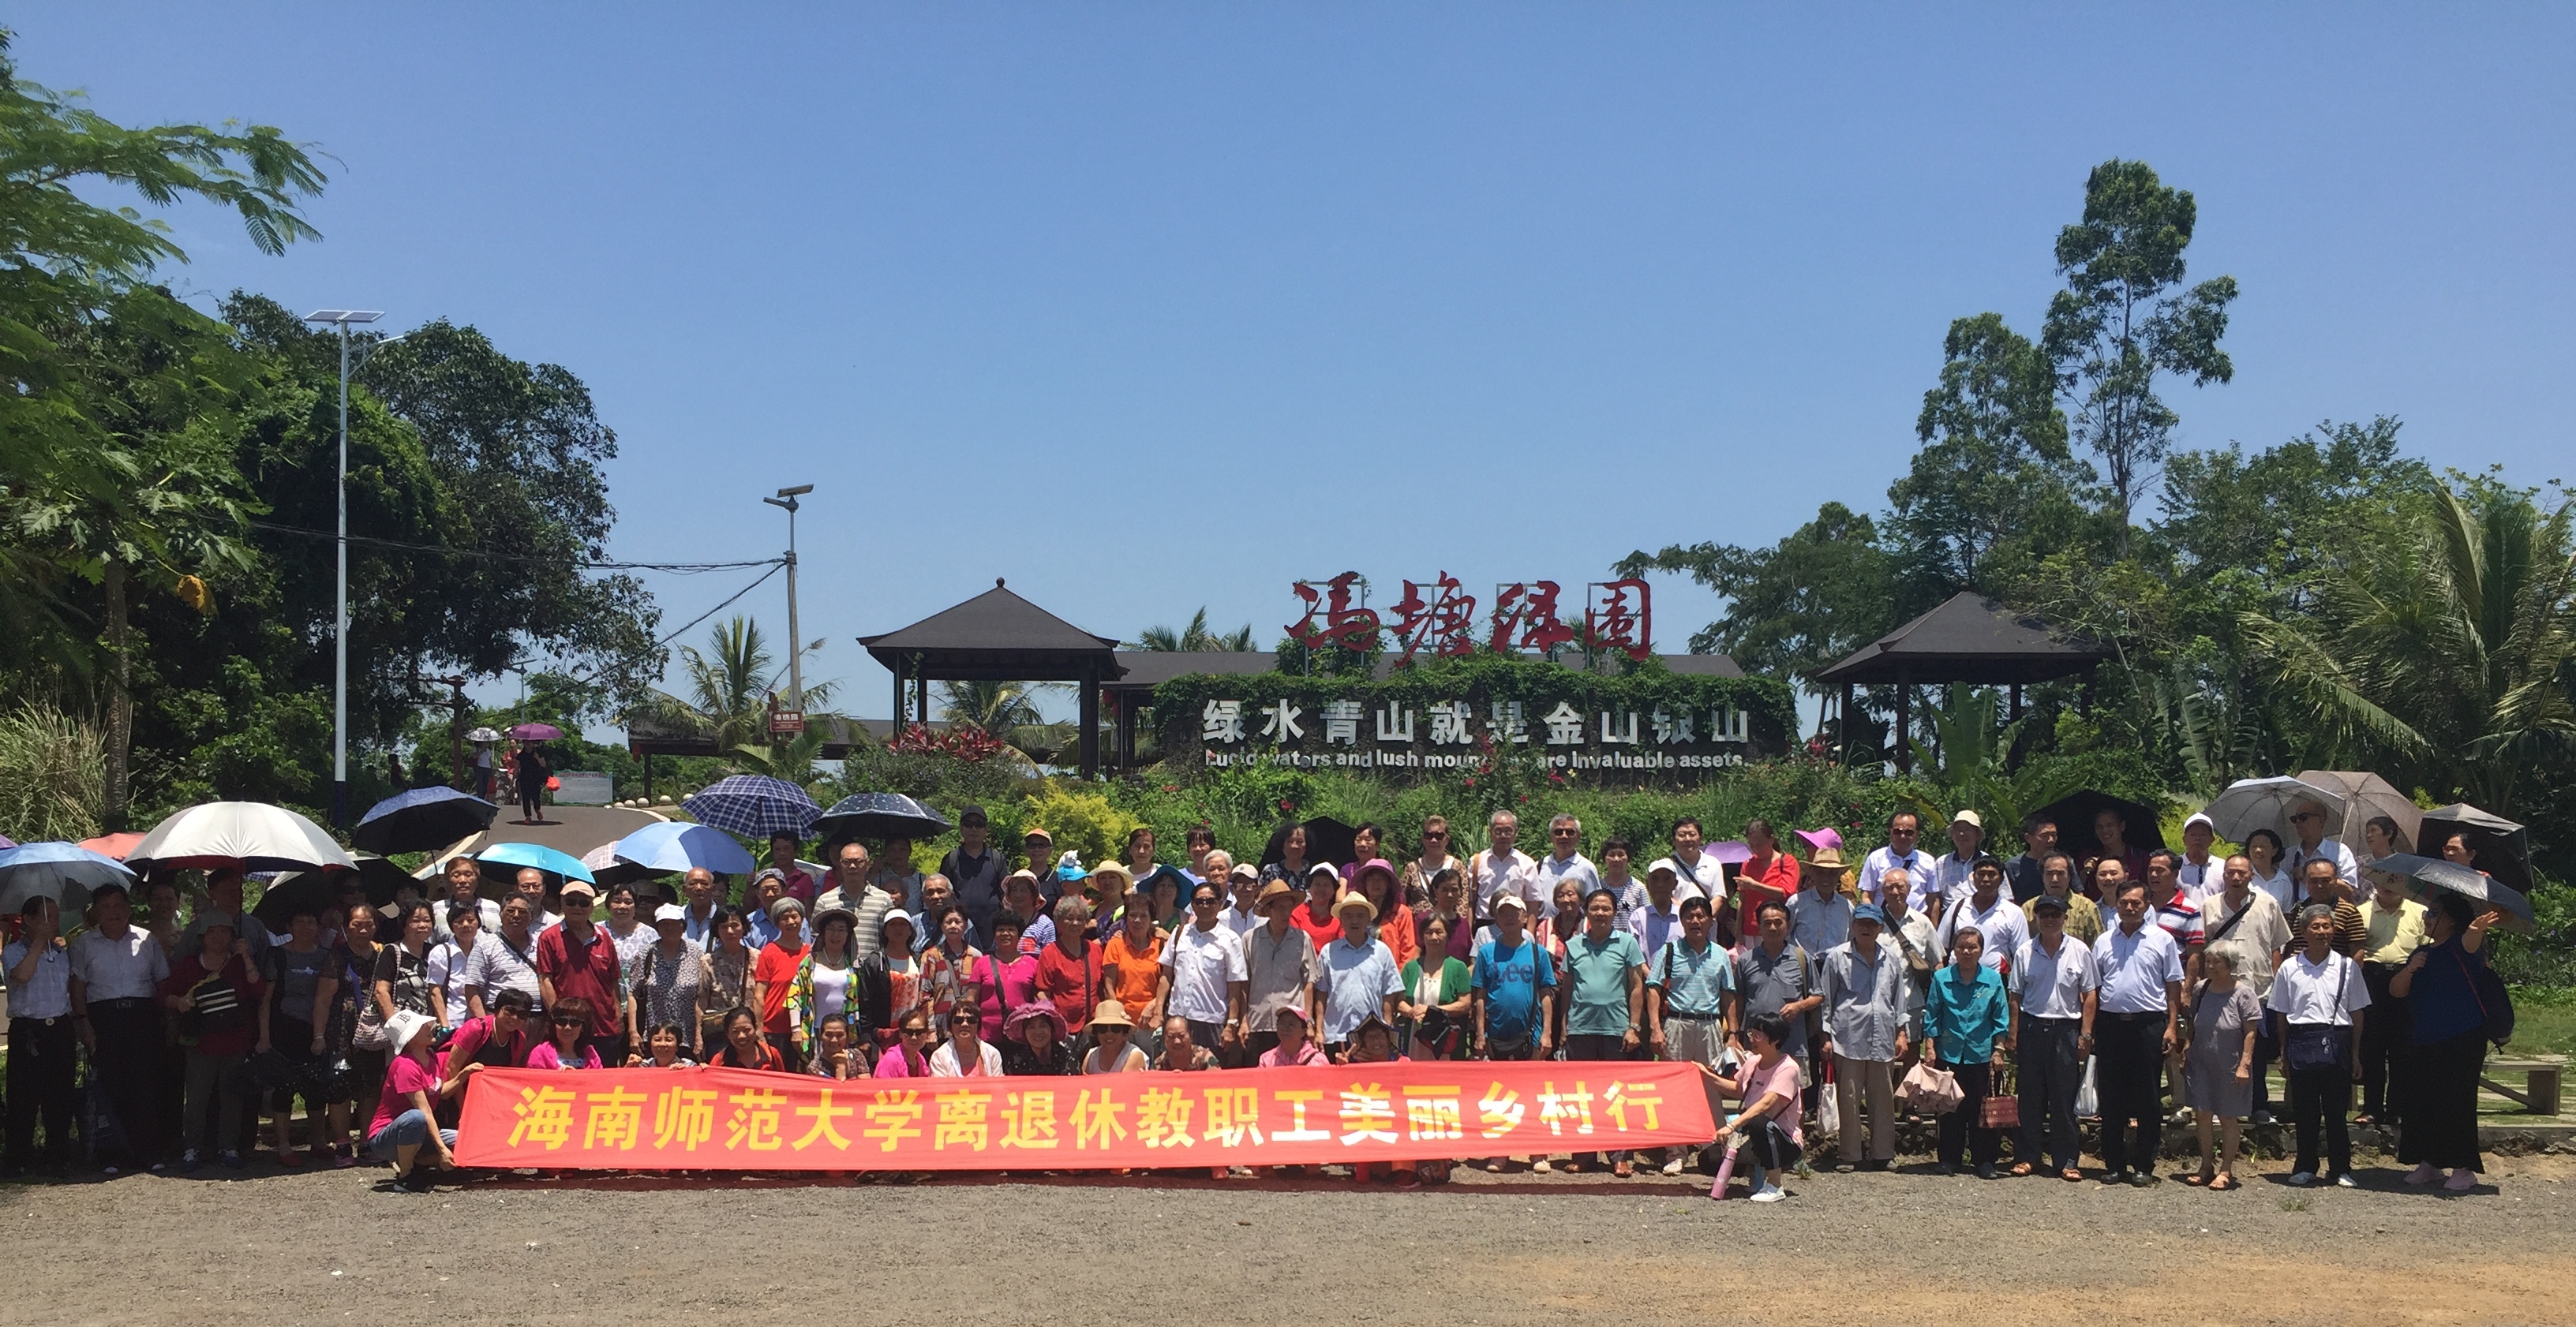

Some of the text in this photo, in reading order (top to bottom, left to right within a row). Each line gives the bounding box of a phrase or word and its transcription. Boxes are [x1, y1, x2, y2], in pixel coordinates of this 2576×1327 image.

[1283, 570, 1651, 667] 冯塘绿园
[1202, 698, 1748, 745] 绿水青山就是金山银山
[1262, 750, 1331, 768] atrs
[1336, 750, 1372, 768] and
[1376, 749, 1418, 767] lush
[1538, 754, 1567, 768] are
[1492, 962, 1533, 984] Lee
[507, 1080, 1663, 1152] 海南师范大学离退休教职工美丽乡村行
